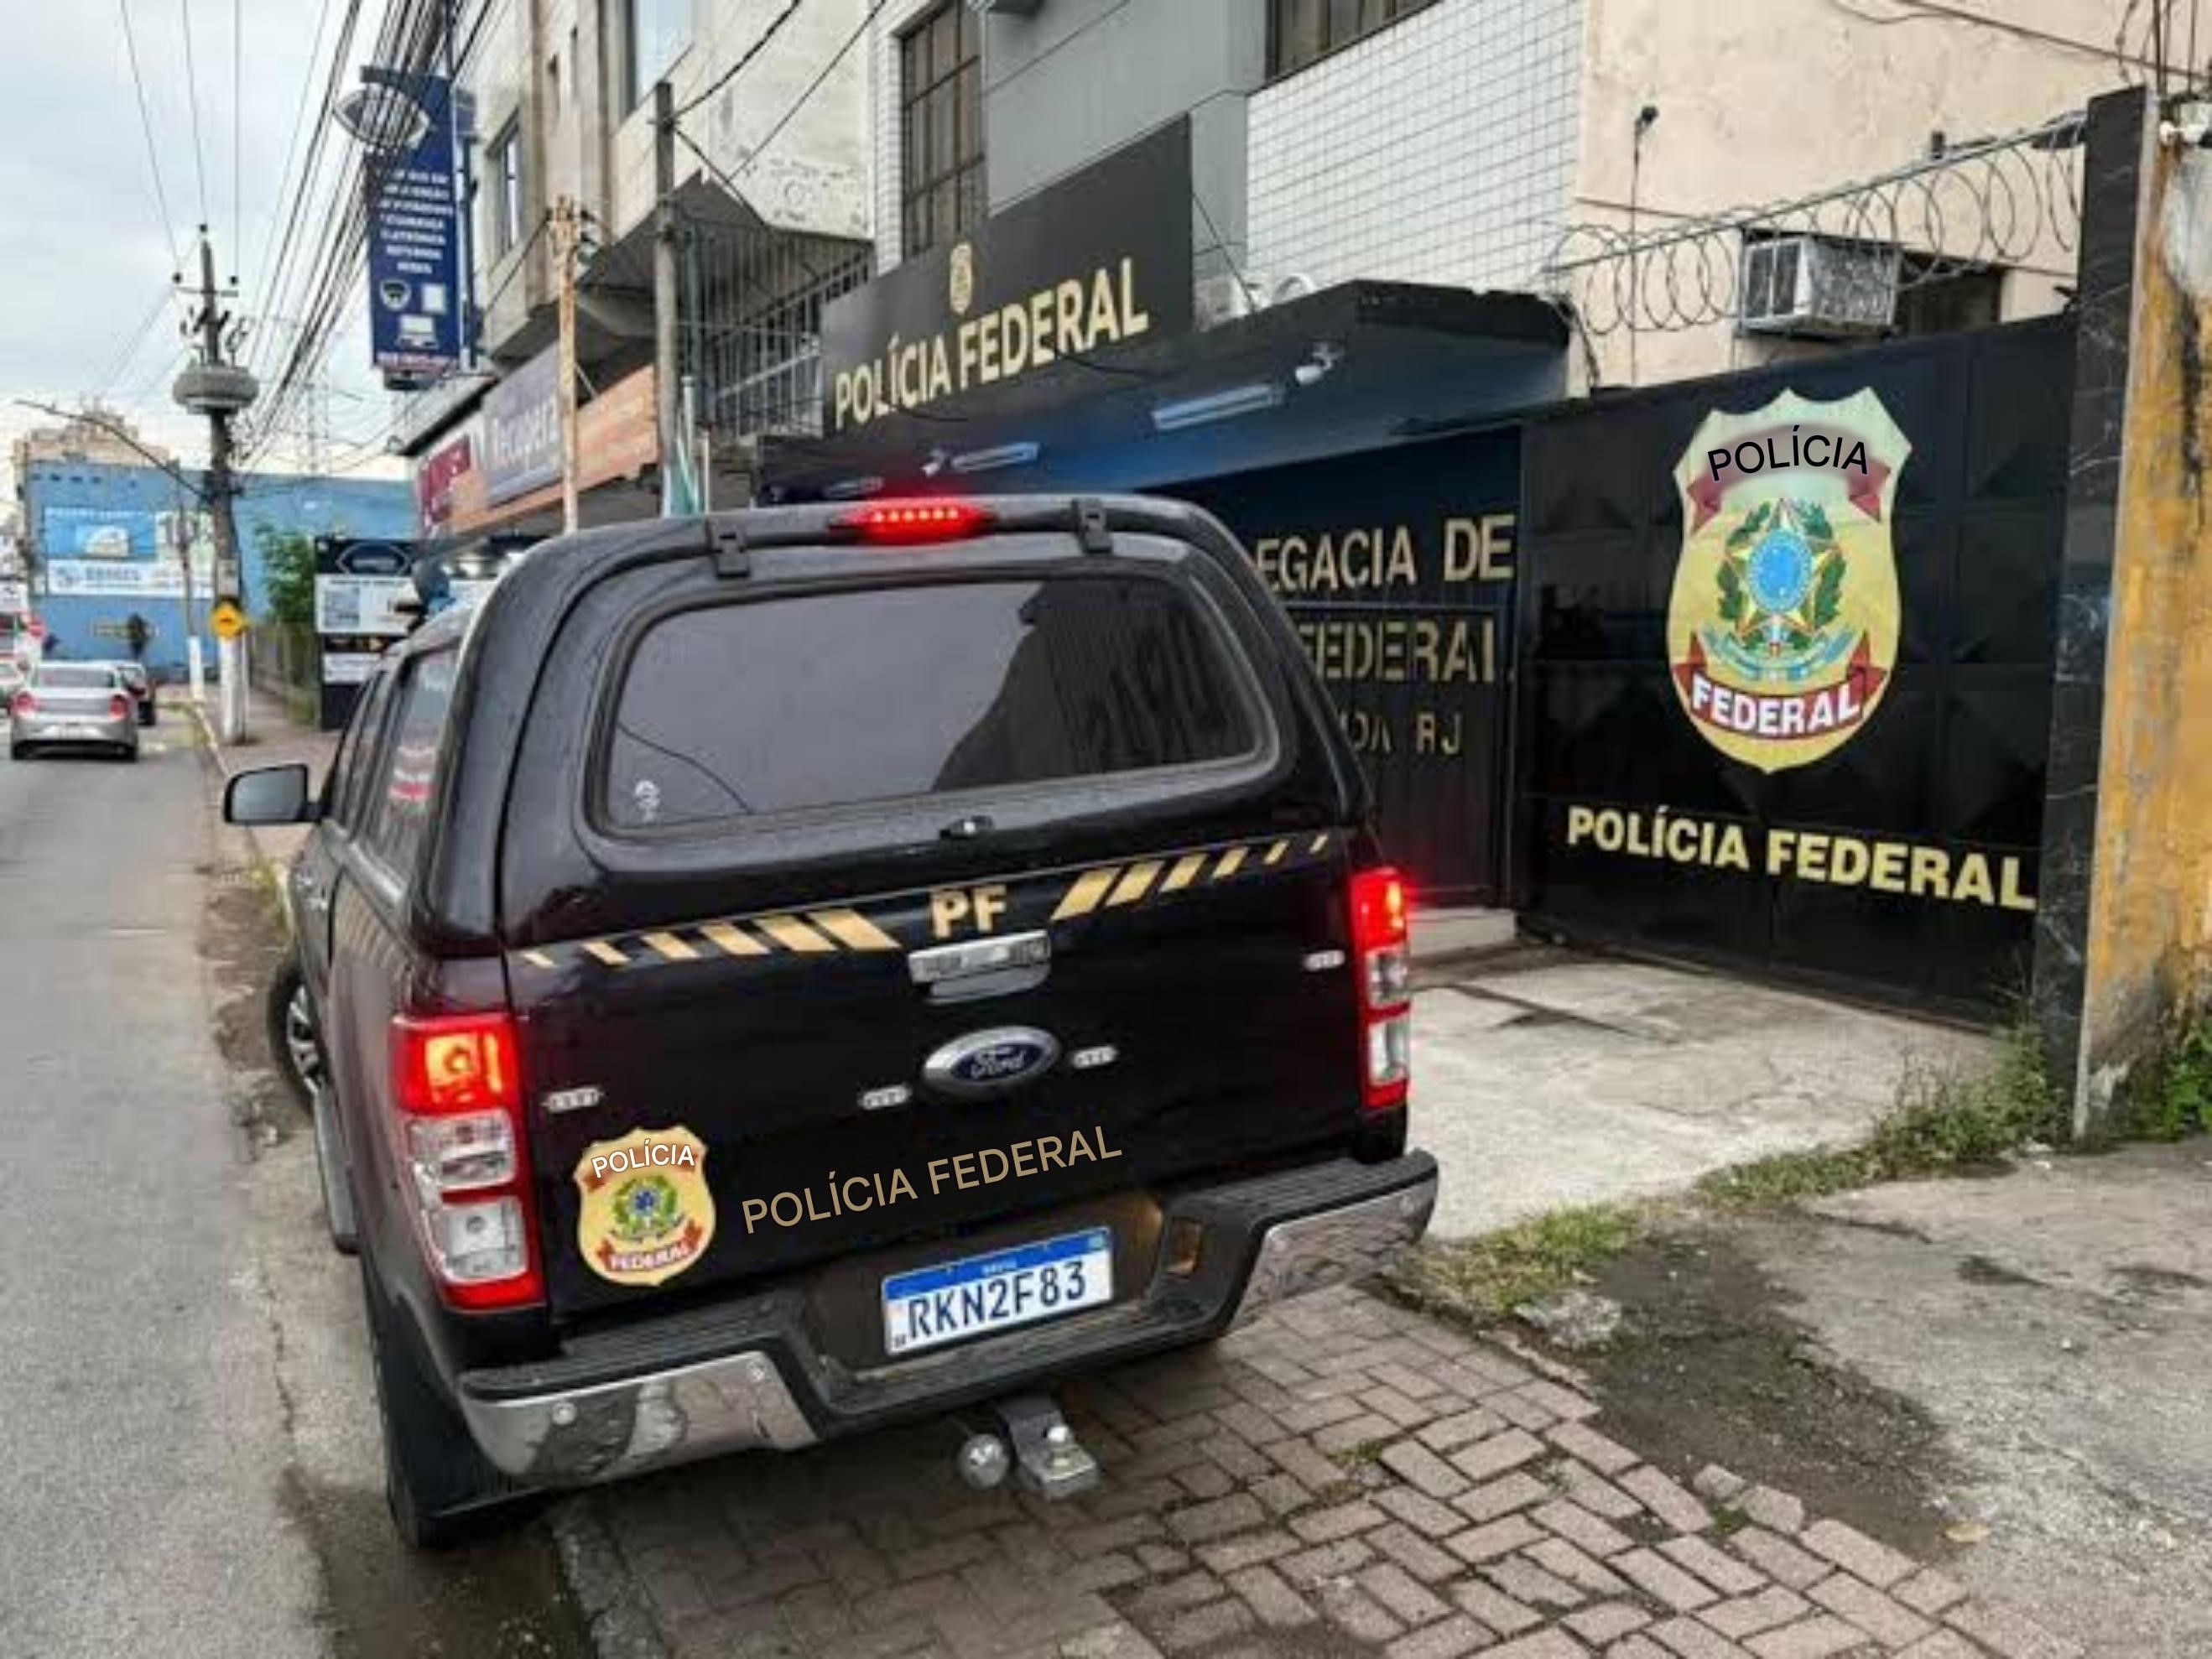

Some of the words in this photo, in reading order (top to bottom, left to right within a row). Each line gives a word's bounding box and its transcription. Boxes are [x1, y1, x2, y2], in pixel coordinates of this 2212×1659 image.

[835, 331, 951, 429] POLÍCIA
[958, 257, 1149, 390] FEDERAL
[1707, 424, 1869, 481] POLÍCIA
[1257, 524, 1418, 590] EGACIA
[1443, 514, 1516, 582] DE
[1692, 674, 1861, 735] FEDERAL
[1567, 804, 1750, 871] POLÍCIA
[1766, 828, 2037, 911] FEDERAL
[930, 885, 1007, 939] PF
[591, 1138, 695, 1178] POLÍCIA
[742, 1168, 919, 1234] POLÍCIA
[927, 1126, 1122, 1195] FEDERAL
[908, 1261, 1086, 1339] RKN2F83
